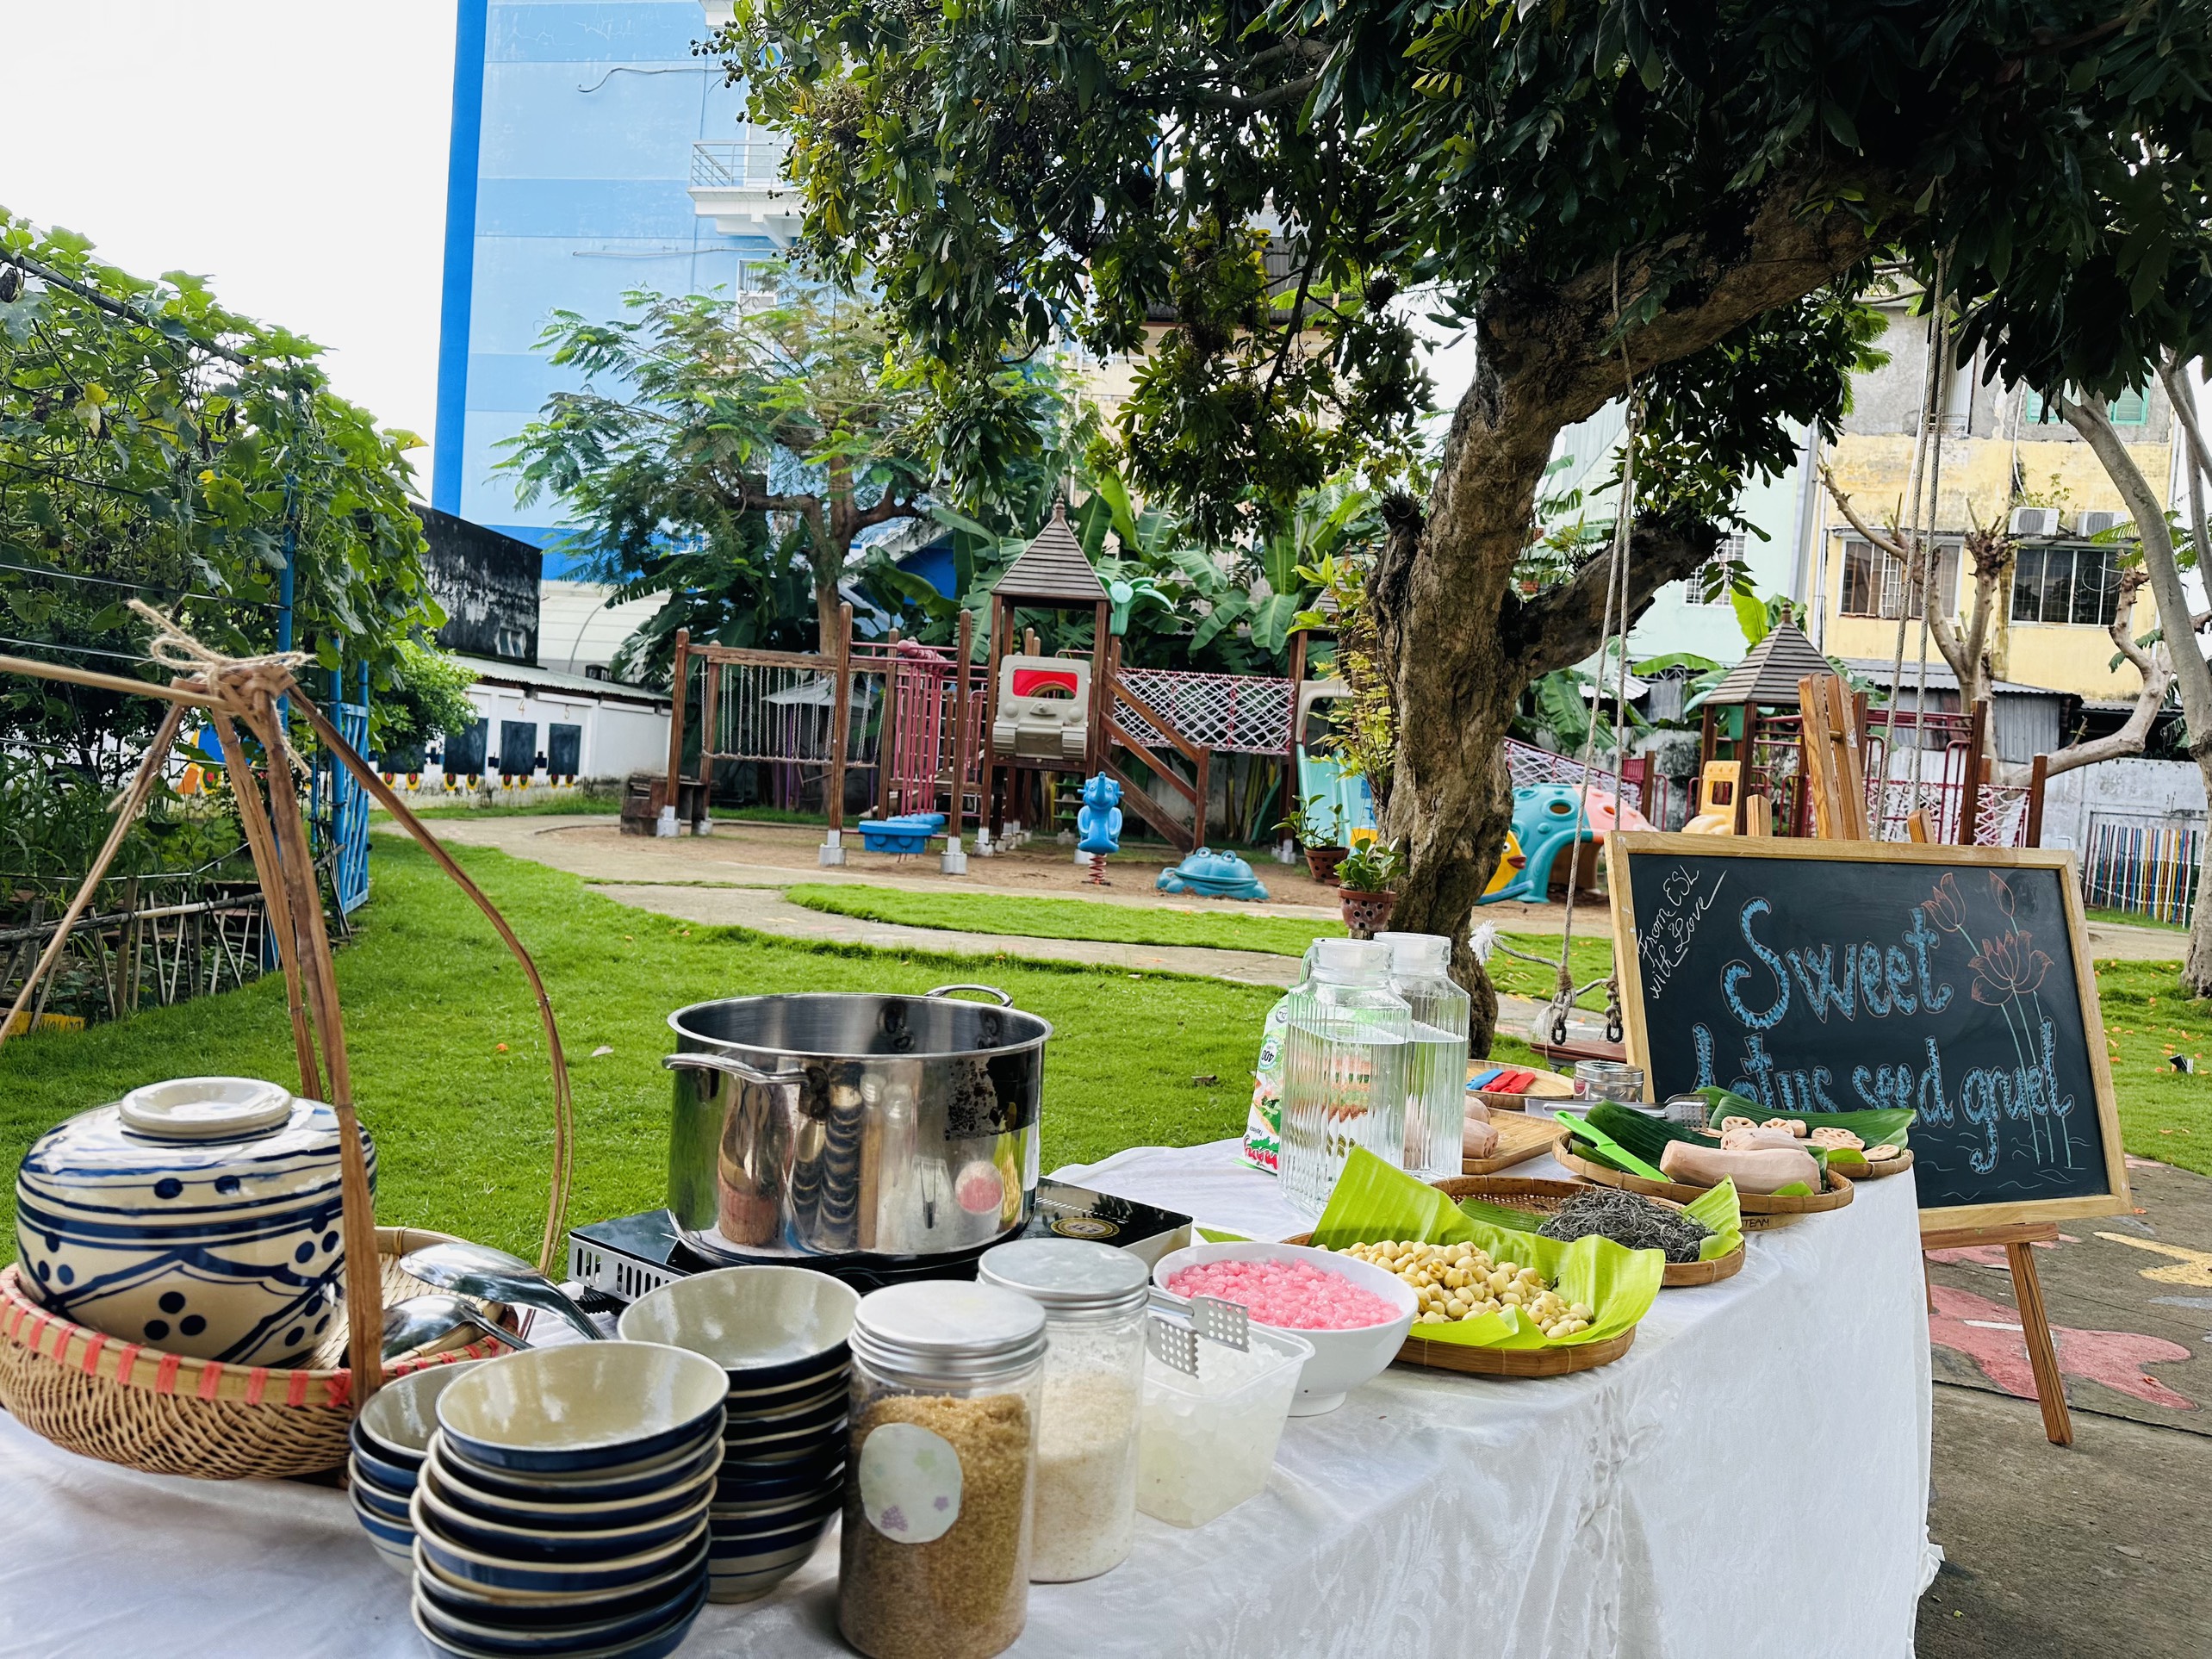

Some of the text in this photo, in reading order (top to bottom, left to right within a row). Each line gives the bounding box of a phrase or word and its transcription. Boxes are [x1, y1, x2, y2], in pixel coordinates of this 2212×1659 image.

[1637, 864, 1699, 968] From ESL
[1650, 869, 1728, 999] with Love
[1720, 896, 1954, 1029] Sweet
[1852, 1035, 1954, 1129] seed
[1959, 1016, 2075, 1175] gruel
